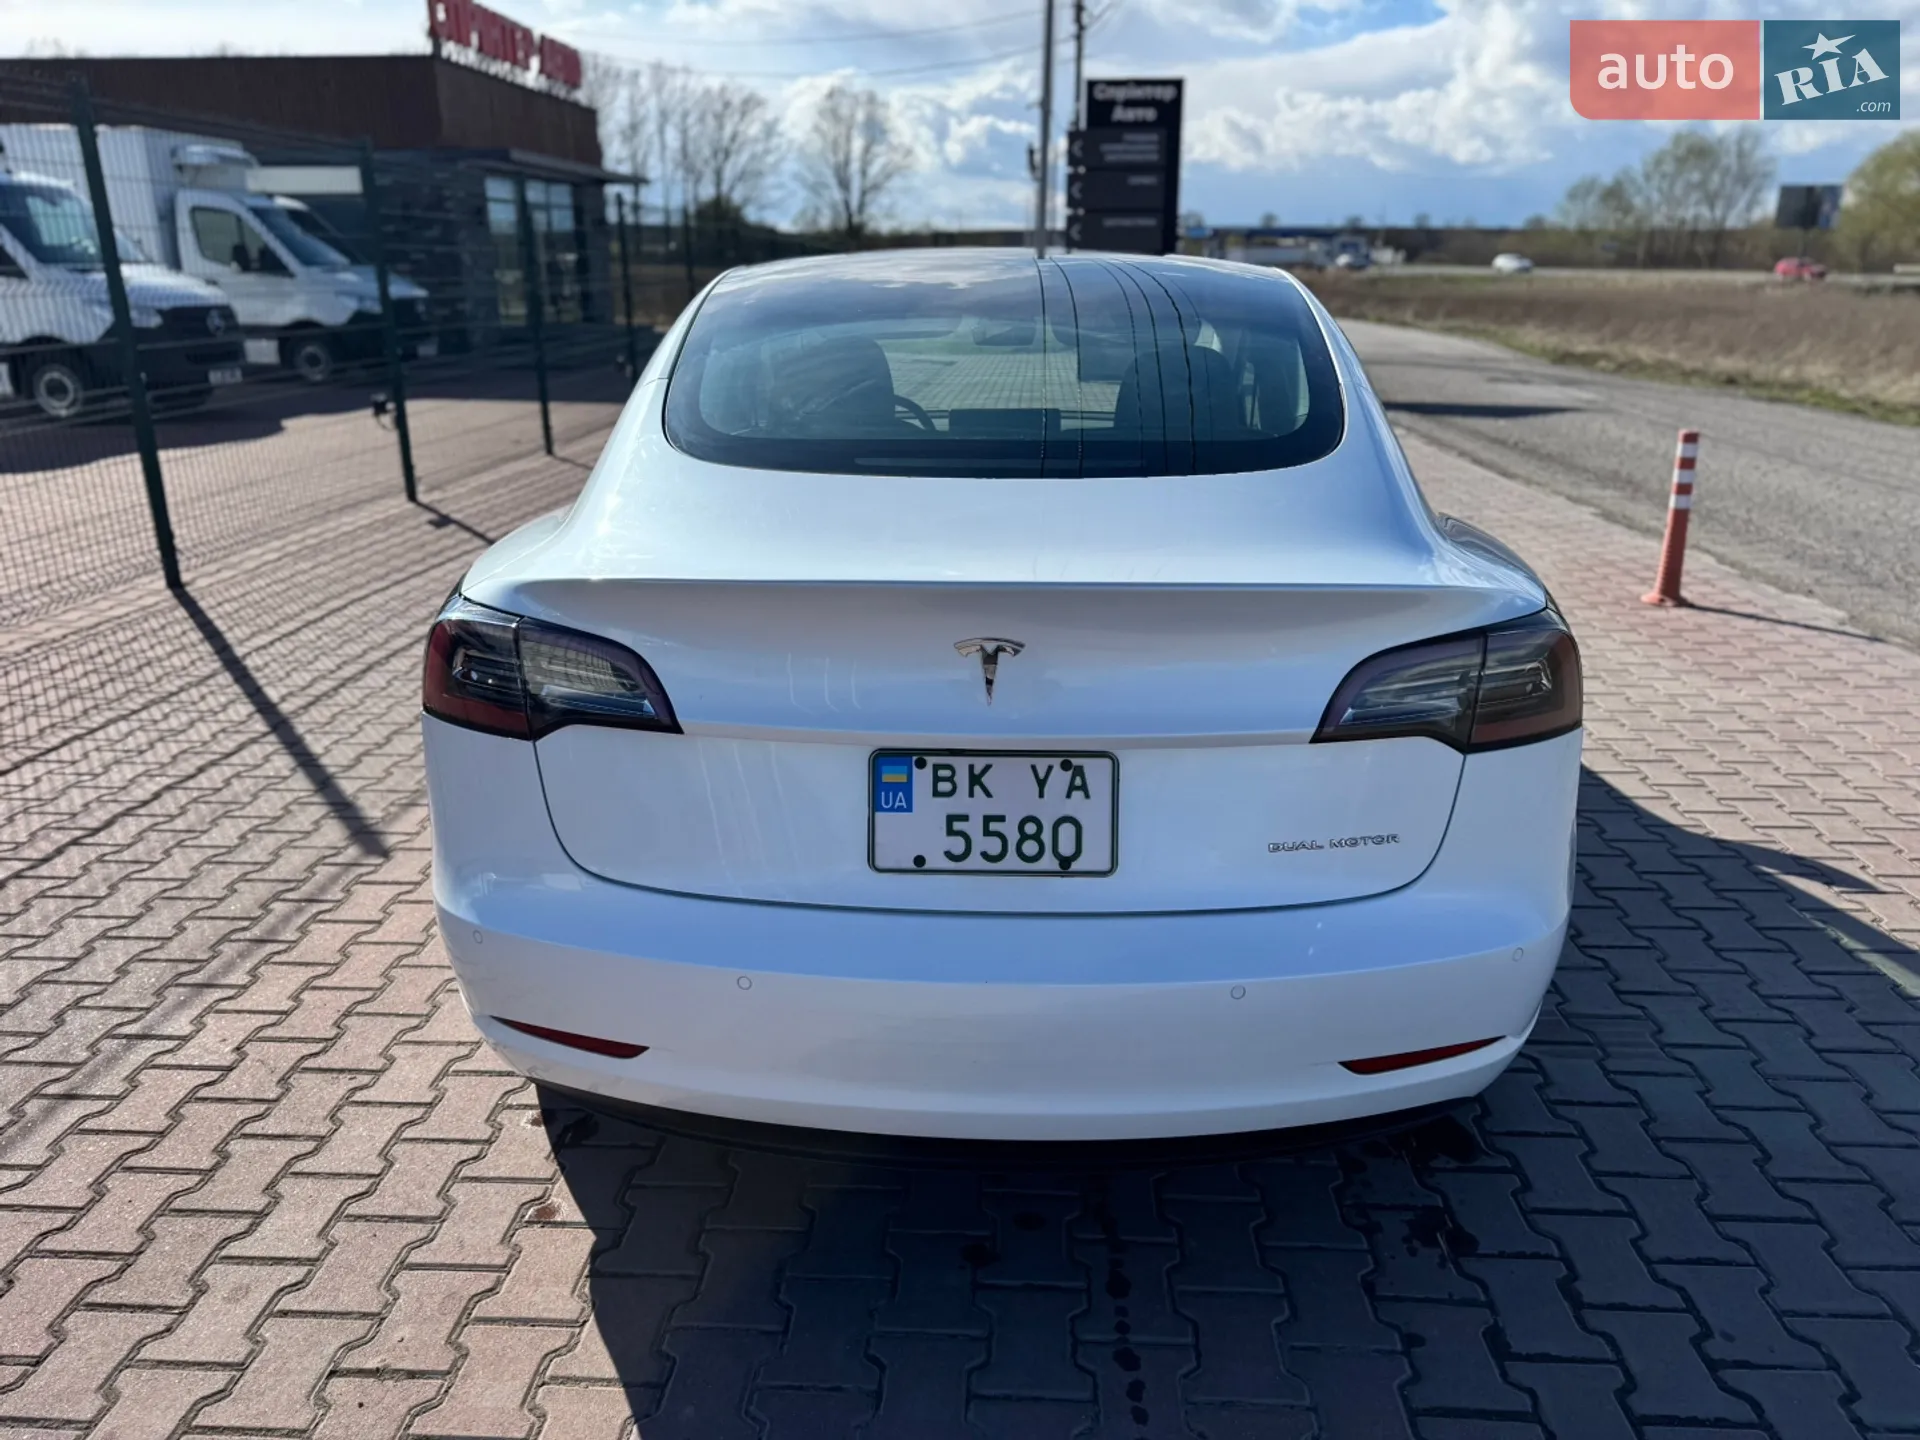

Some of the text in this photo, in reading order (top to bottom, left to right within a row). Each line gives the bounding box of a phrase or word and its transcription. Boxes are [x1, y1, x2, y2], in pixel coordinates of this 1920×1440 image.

[931, 763, 1091, 799] BK YA
[880, 791, 908, 810] UA
[943, 814, 1084, 864] 5580
[1268, 833, 1400, 853] DUAL MOTOR
